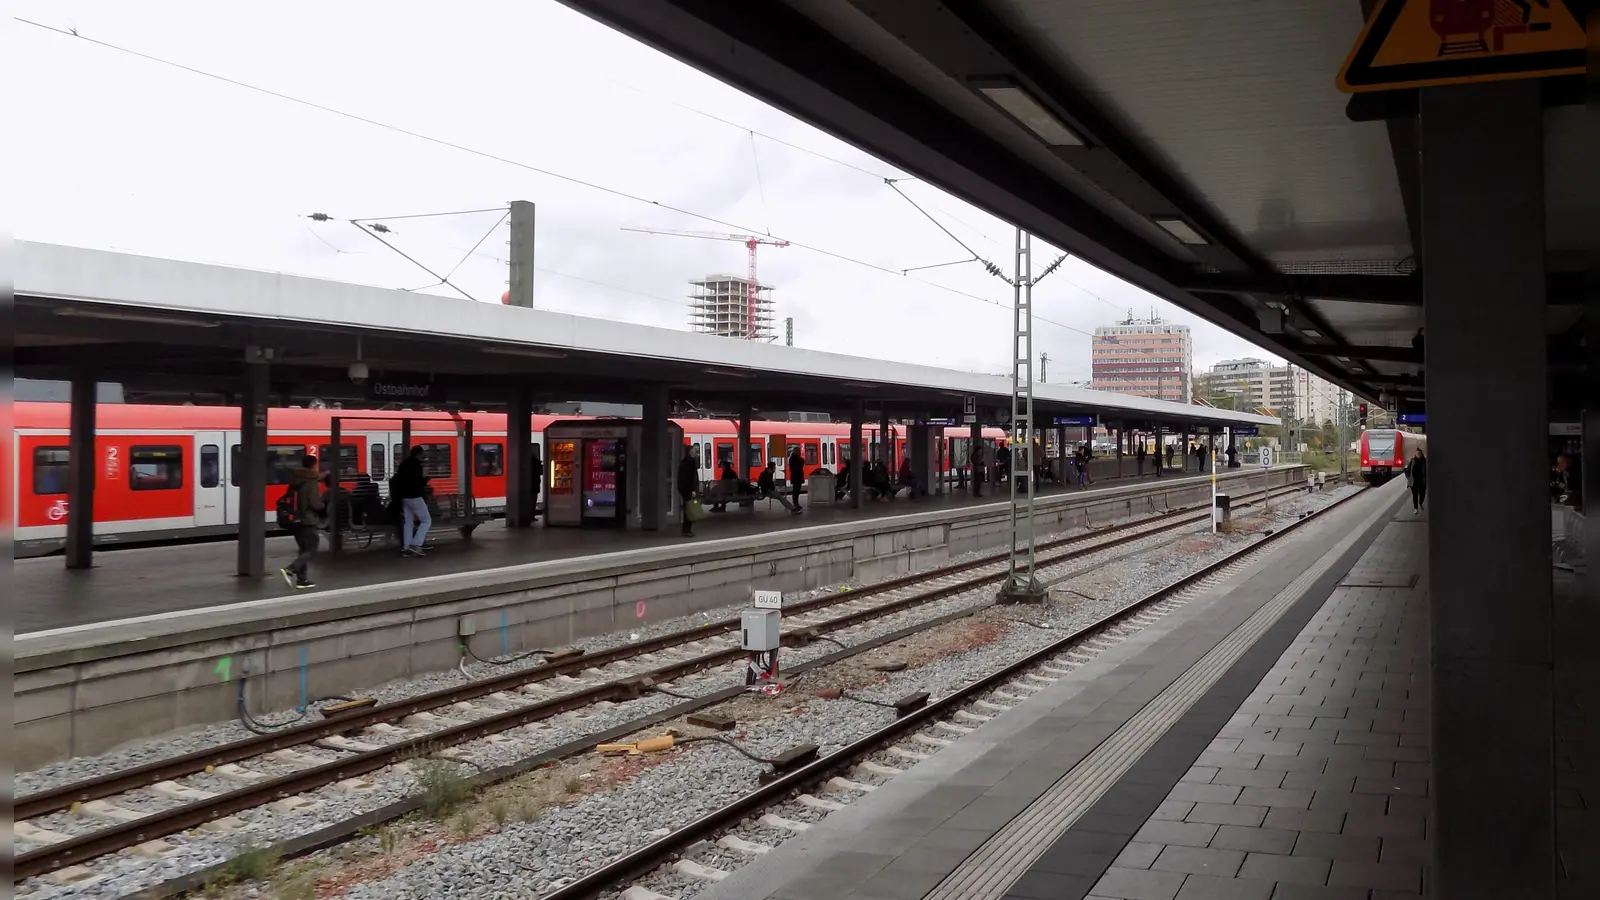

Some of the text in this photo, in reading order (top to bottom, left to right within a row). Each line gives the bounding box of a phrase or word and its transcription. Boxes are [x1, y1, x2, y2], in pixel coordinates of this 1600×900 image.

[373, 382, 430, 397] Ostbahnhof
[965, 397, 975, 413] H
[1387, 397, 1397, 411] H
[107, 447, 118, 460] 2
[308, 445, 317, 457] 2
[769, 596, 778, 604] 40
